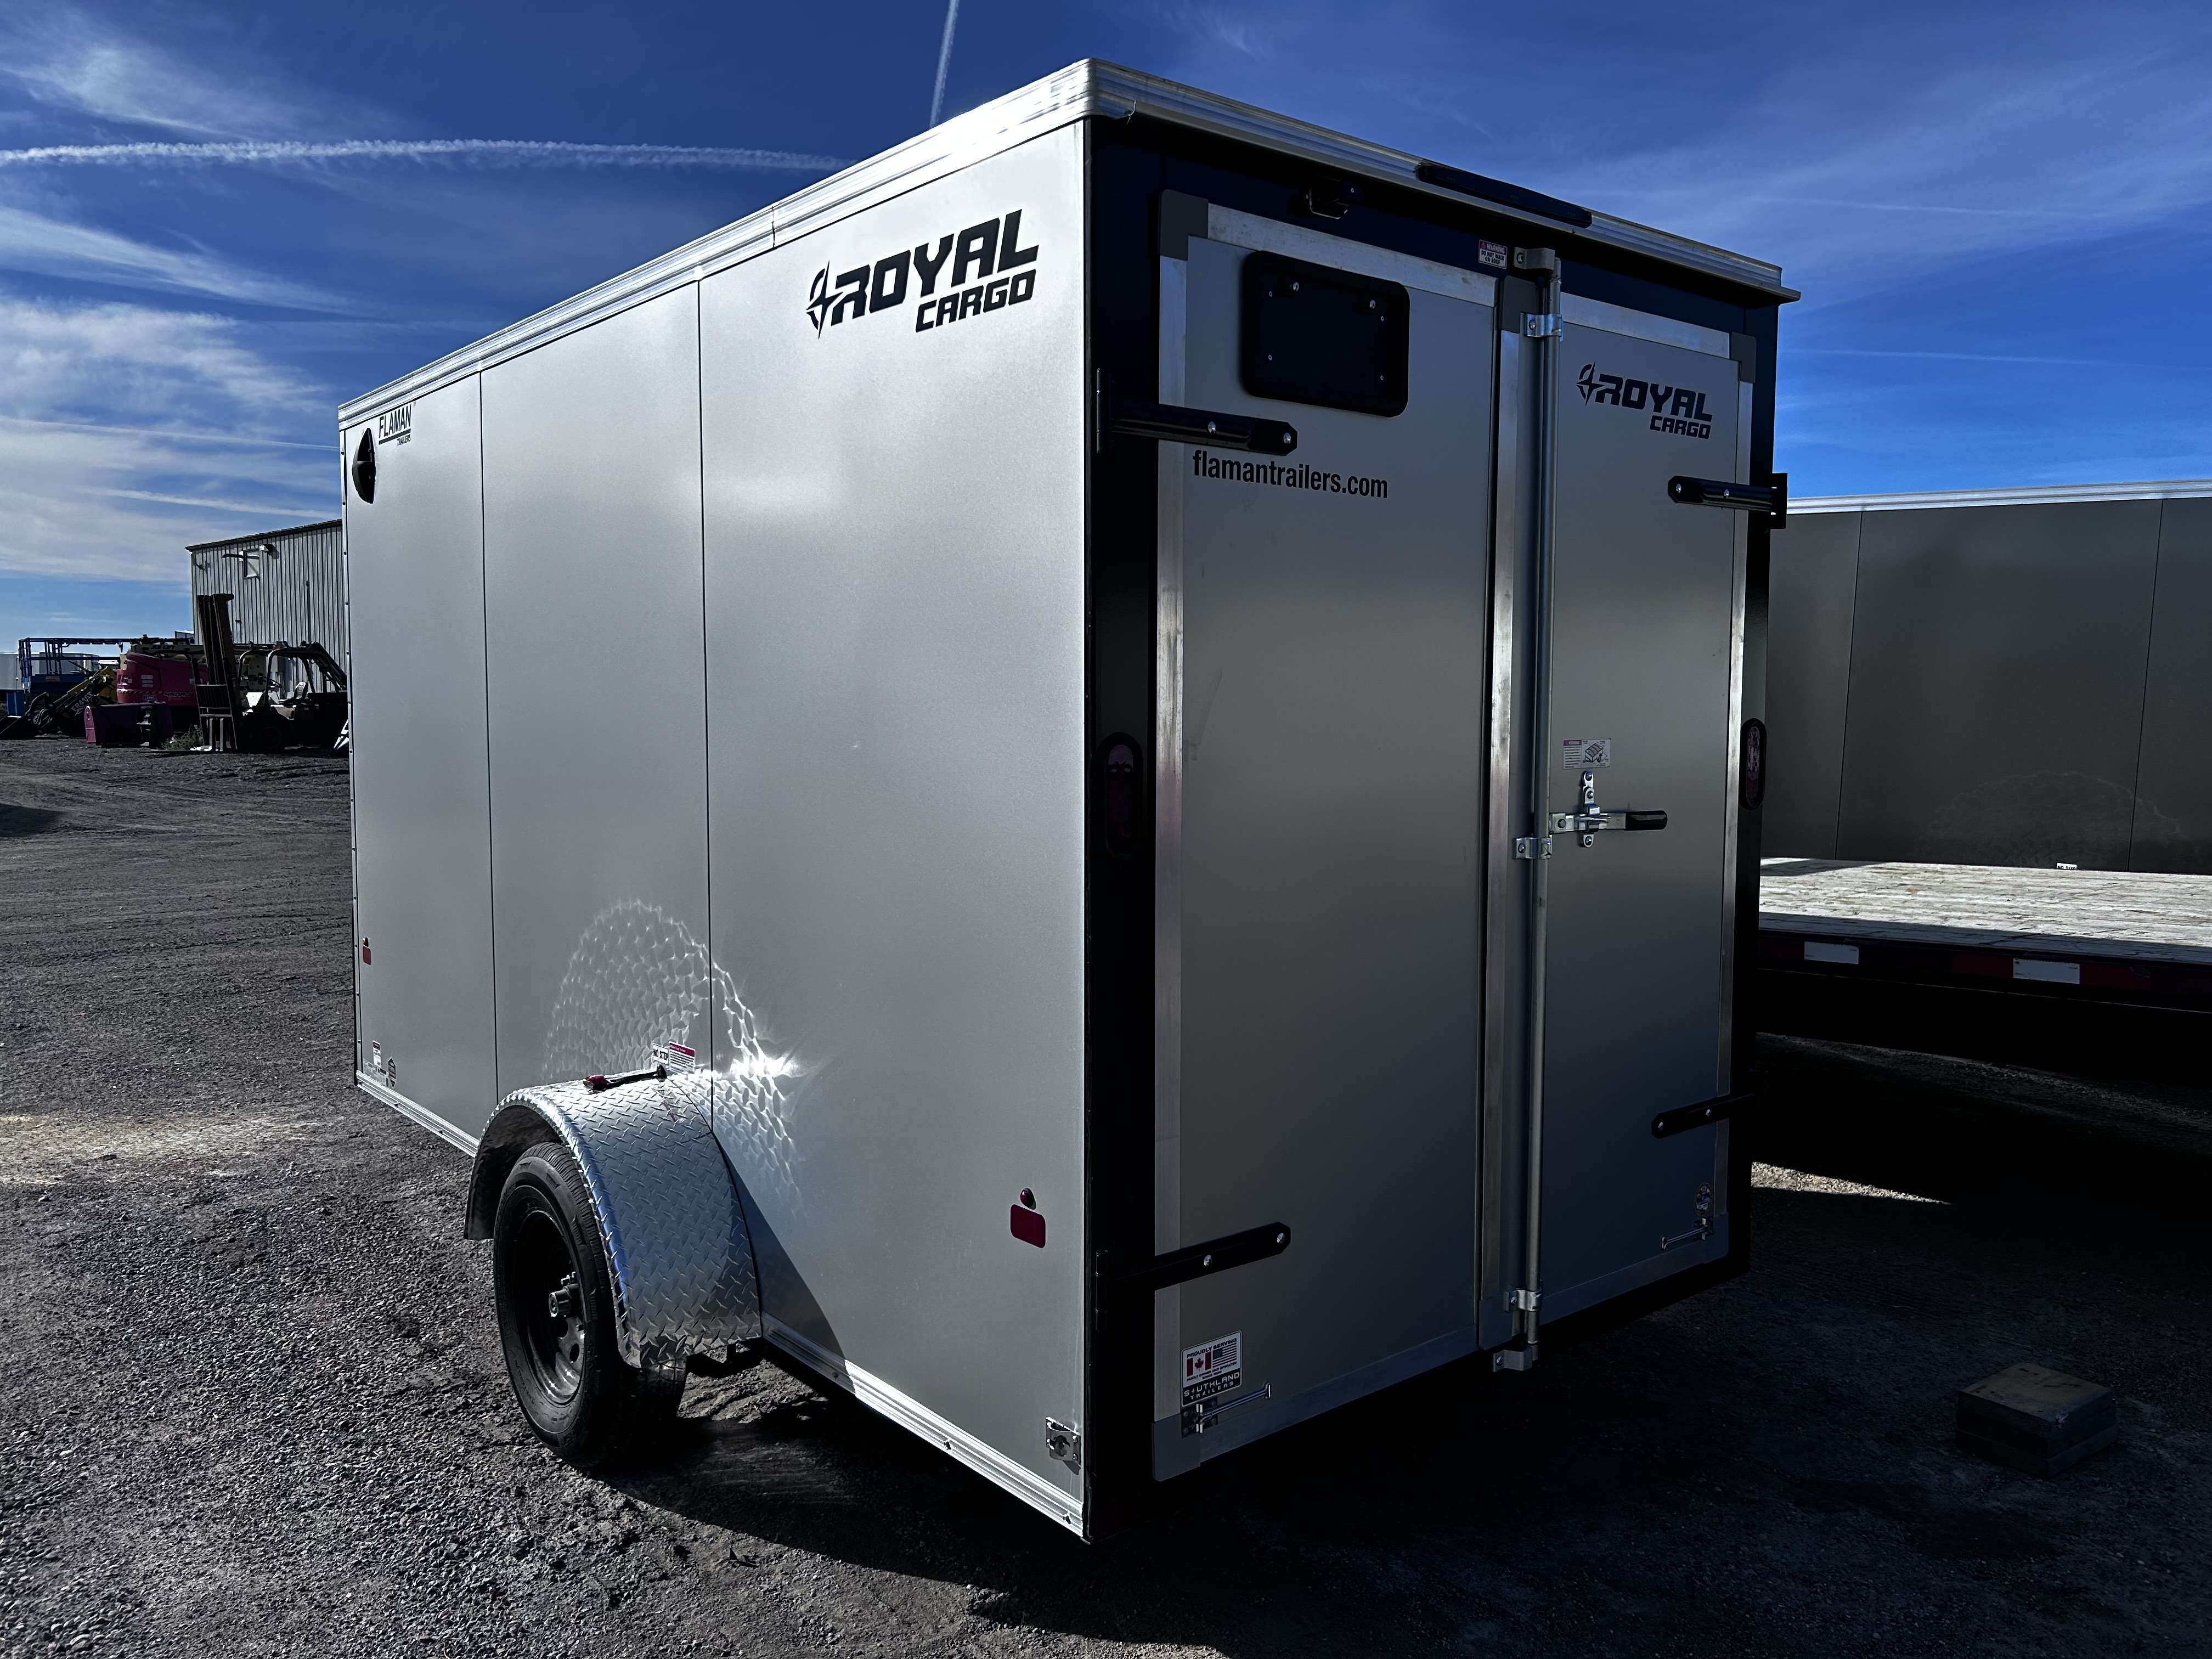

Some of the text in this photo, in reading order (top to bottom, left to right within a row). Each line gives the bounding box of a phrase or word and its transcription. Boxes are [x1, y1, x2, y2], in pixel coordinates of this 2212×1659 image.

[831, 209, 1039, 326] ROYAL
[915, 269, 1036, 333] CARGO
[1594, 373, 1713, 422] ROYAL
[379, 404, 412, 438] FLAMAN
[1650, 415, 1711, 439] CARGO
[397, 434, 411, 446] TRAILERS
[1192, 449, 1388, 498] flamantrailers.com
[653, 1048, 659, 1058] NO
[659, 1051, 669, 1060] STEP
[1186, 1338, 1237, 1359] PROUDLY SERVING
[1190, 1382, 1234, 1400] TRAILERS
